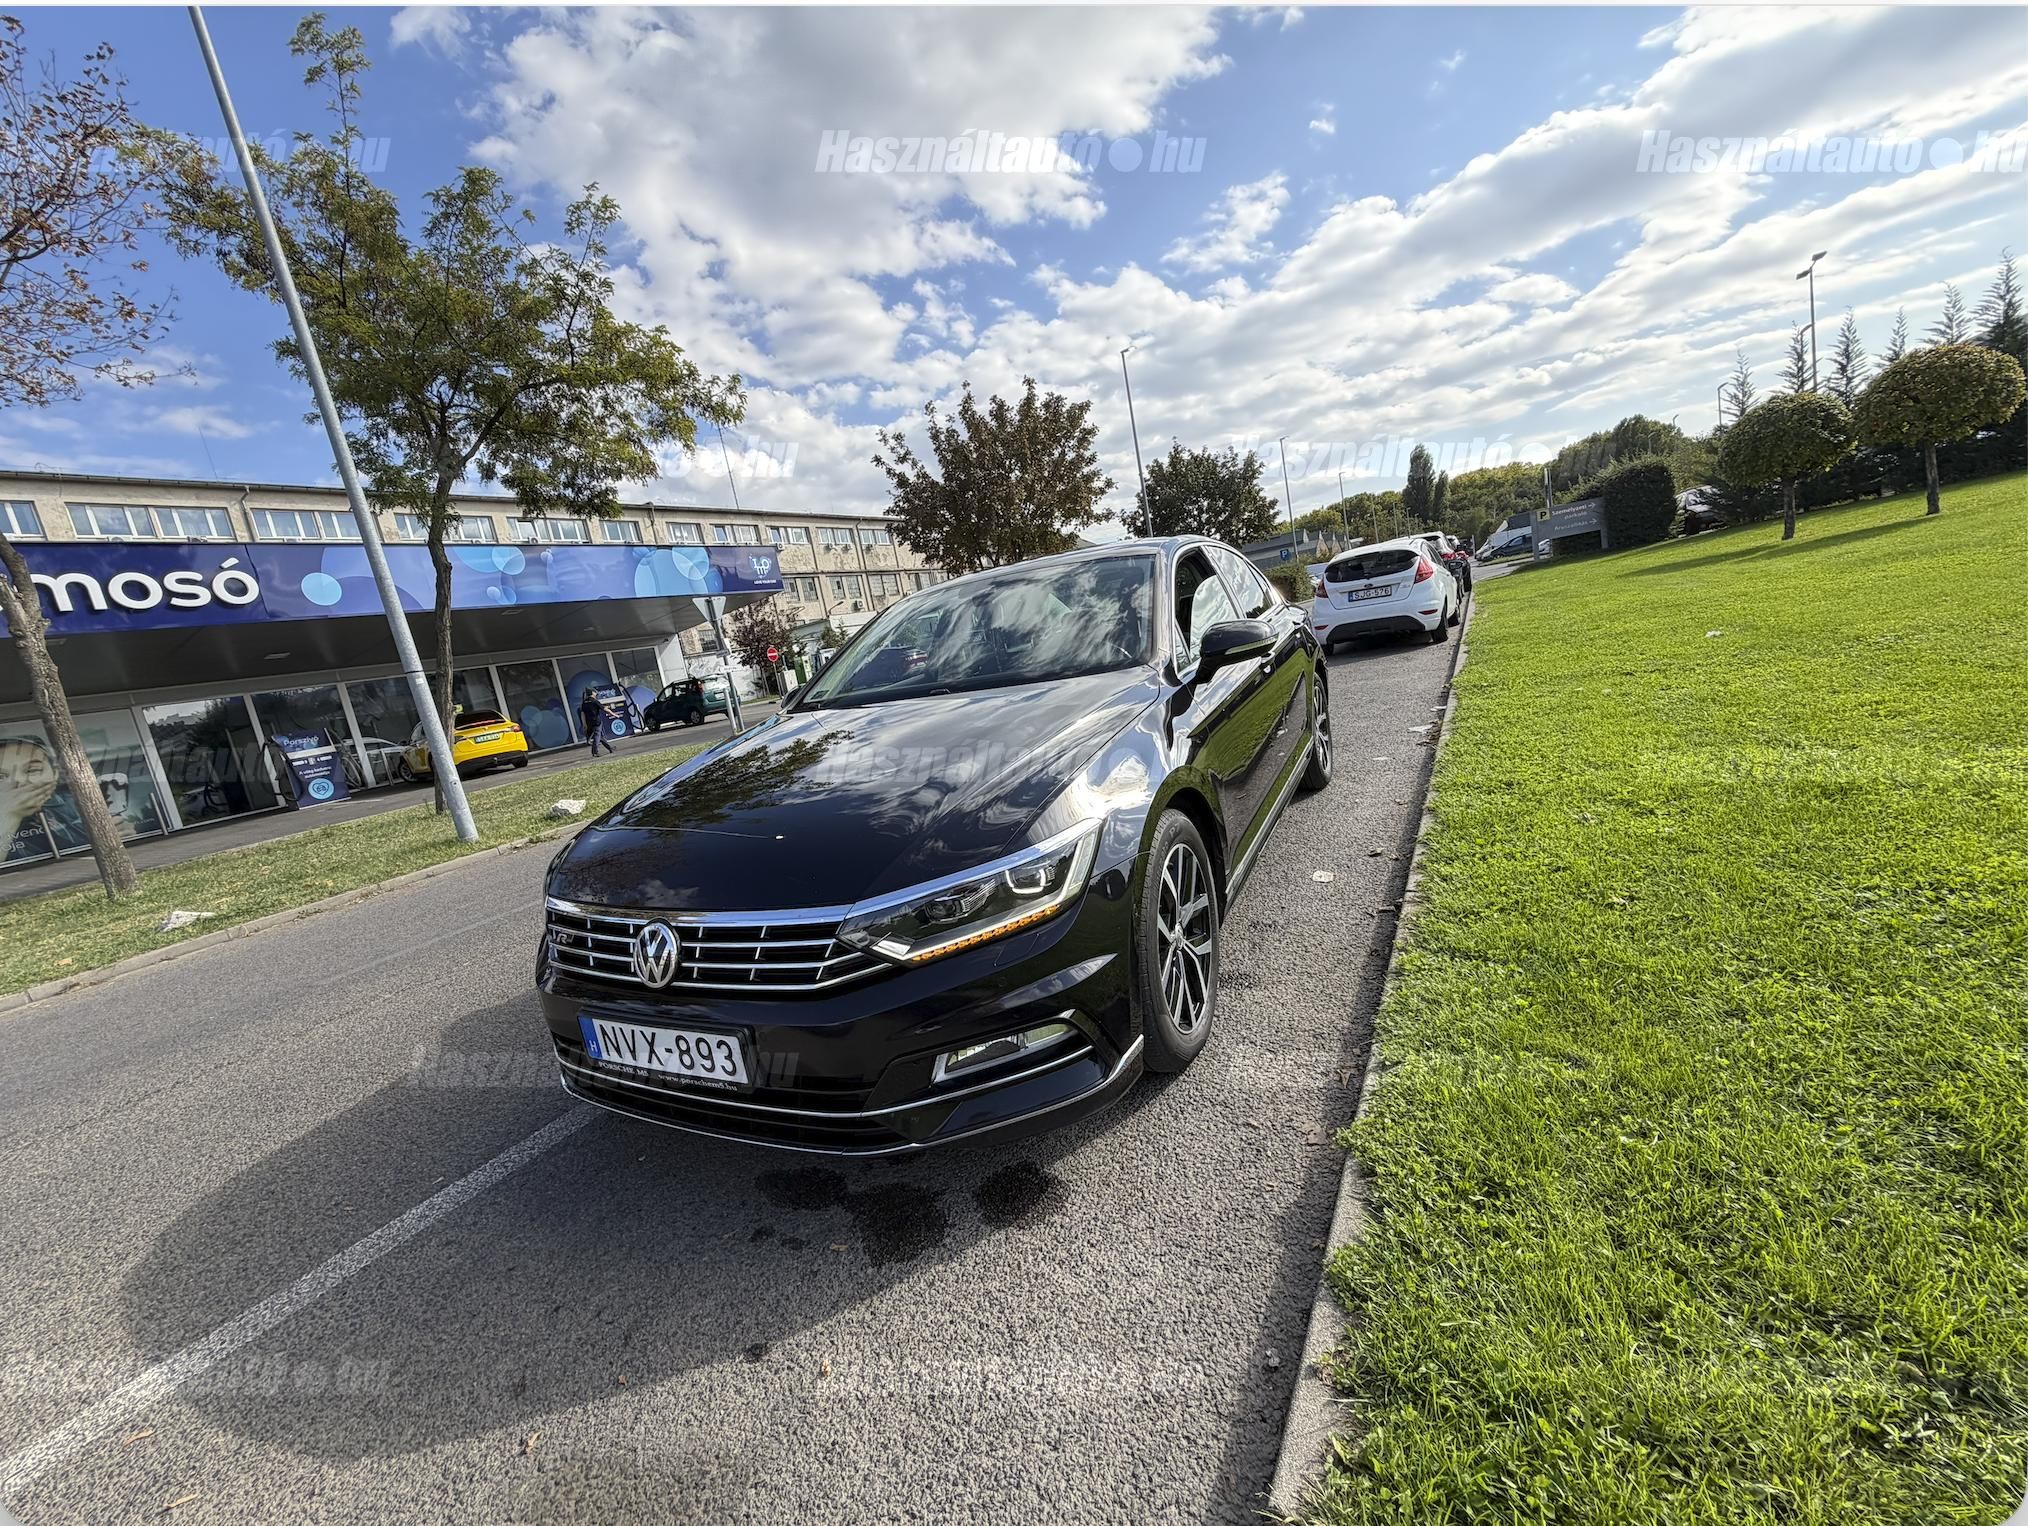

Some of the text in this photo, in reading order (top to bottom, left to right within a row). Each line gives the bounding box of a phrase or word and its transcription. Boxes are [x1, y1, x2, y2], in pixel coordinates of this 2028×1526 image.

[1540, 511, 1547, 520] P
[1354, 587, 1390, 599] SJG-576
[589, 1039, 597, 1053] H
[599, 1023, 737, 1077] NVX-893
